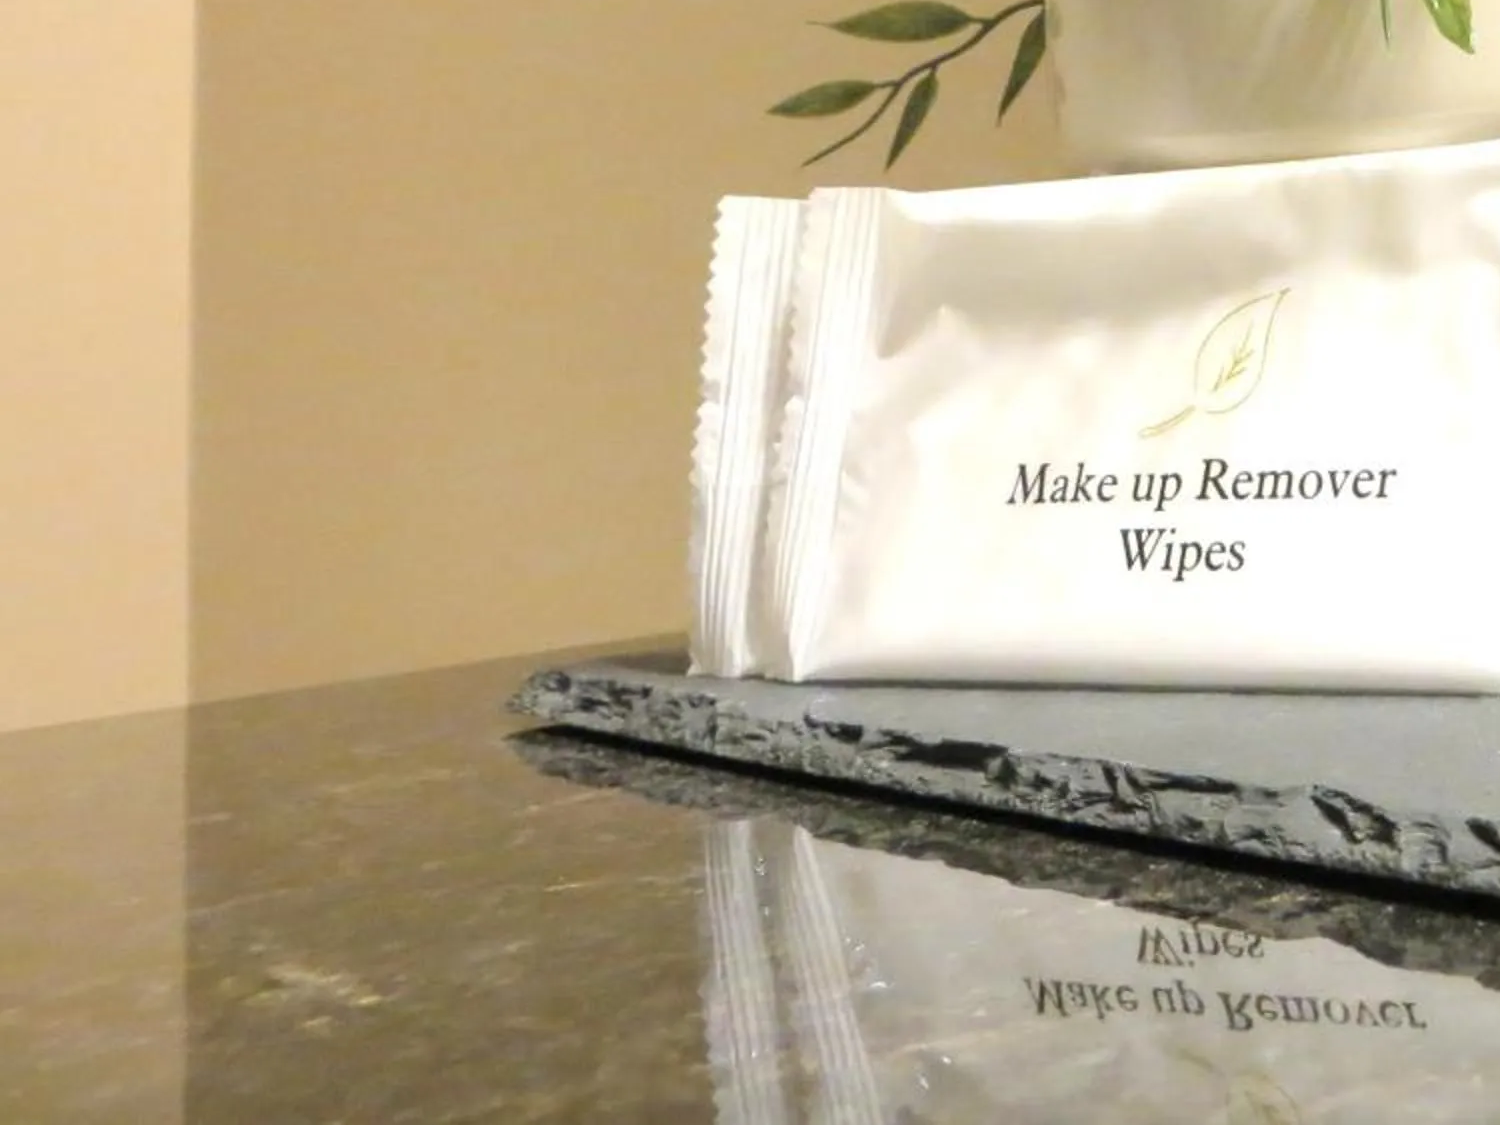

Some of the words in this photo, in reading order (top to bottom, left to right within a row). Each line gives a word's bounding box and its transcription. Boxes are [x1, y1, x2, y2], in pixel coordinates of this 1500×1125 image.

[1006, 461, 1118, 506] Make
[1132, 474, 1182, 512] up
[1195, 458, 1397, 501] Remover
[1120, 528, 1247, 582] Wipes
